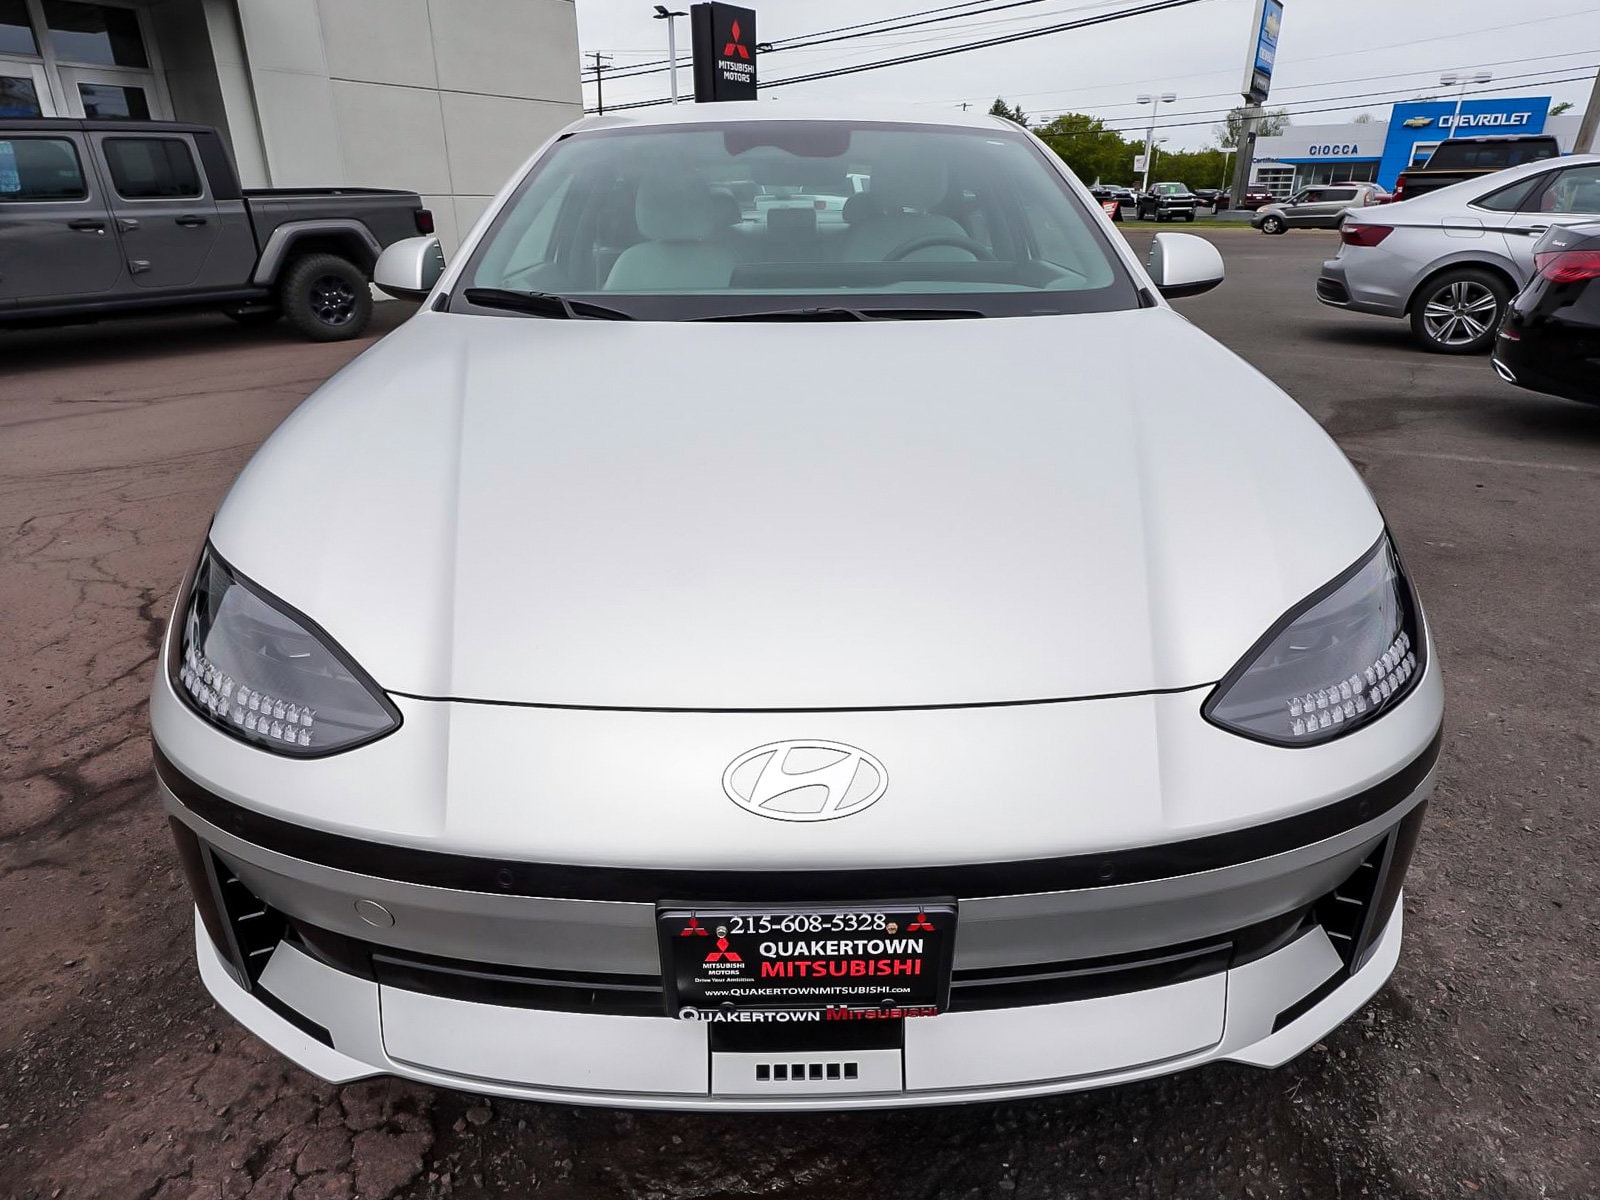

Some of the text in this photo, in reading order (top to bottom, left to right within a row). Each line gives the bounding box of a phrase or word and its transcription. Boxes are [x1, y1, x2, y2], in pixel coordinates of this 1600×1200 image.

[718, 60, 755, 74] MITSUBISHI
[723, 71, 750, 83] MOTORS
[1438, 112, 1532, 128] CHEVROLET
[1309, 144, 1359, 156] CIOCCA
[729, 913, 887, 935] 215-608-5328
[759, 938, 924, 959] QUAKERTOWN
[761, 959, 922, 978] MITSUBISHI
